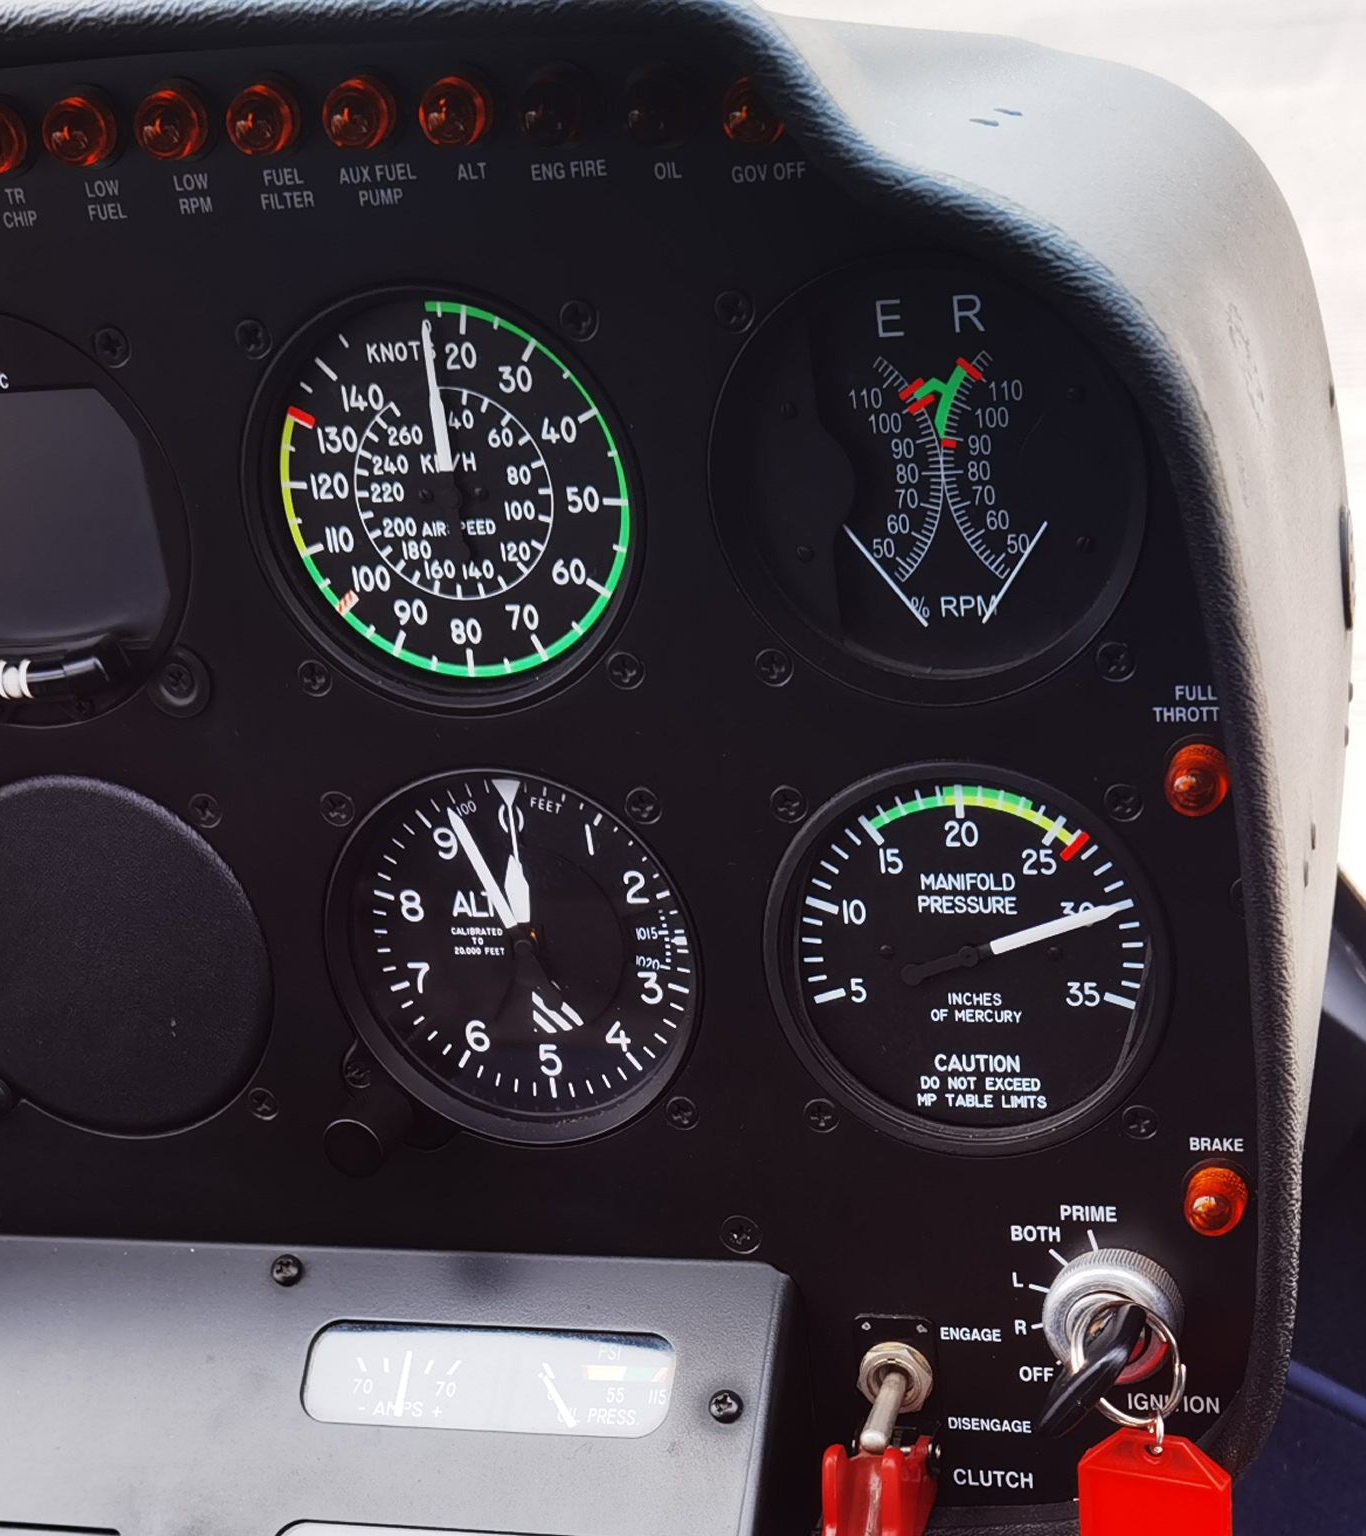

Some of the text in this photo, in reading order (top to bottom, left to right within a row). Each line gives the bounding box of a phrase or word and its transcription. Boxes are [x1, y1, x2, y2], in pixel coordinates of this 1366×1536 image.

[263, 167, 304, 186] FUEL
[339, 162, 417, 184] AUX FUEL
[456, 163, 487, 181] ALT
[531, 159, 607, 182] ENG FIRE
[654, 162, 682, 180] OIL
[731, 162, 806, 183] GOV OFF
[85, 179, 120, 198] LOW
[173, 172, 208, 192] LOW
[4, 188, 25, 205] TR
[180, 197, 213, 215] RPM
[261, 190, 315, 211] FILTER
[359, 188, 404, 207] PUMP
[3, 209, 37, 229] CHIP
[87, 202, 127, 222] FUEL
[875, 294, 985, 338] E R
[445, 342, 477, 369] 20
[498, 366, 532, 393] 30
[341, 383, 384, 413] 140
[317, 426, 358, 454] 130
[541, 416, 577, 444] 40
[310, 473, 349, 500] 120
[566, 486, 600, 513] 50
[352, 564, 391, 593] 100
[552, 559, 586, 585] 60
[940, 595, 998, 618] RPM
[505, 604, 539, 631] 70
[450, 618, 482, 645] 80
[1175, 685, 1217, 701] FULL
[1152, 707, 1220, 722] THROTT
[530, 797, 562, 814] FEET
[945, 821, 978, 847] 20
[879, 848, 903, 874] 15
[1022, 849, 1056, 875] 25
[623, 870, 649, 904] 2
[920, 873, 1015, 891] MANIFOLD
[842, 900, 866, 925] 10
[917, 896, 1017, 915] PRESSURE
[451, 927, 503, 936] CALIBRATED
[637, 971, 663, 1004] 3
[1065, 982, 1100, 1006] 35
[948, 992, 1001, 1006] INCHES
[931, 1009, 1022, 1024] OF MERCURY
[539, 1044, 563, 1076] 5
[935, 1054, 1021, 1073] CAUTION
[920, 1076, 1041, 1091] DO NOT EXCEED
[917, 1093, 1047, 1109] MP TABLE LIMITS
[1189, 1137, 1244, 1152] BRAKE
[1059, 1205, 1118, 1223] PRIME
[1011, 1225, 1061, 1243] BOTH
[940, 1327, 1002, 1343] ENGAGE
[1019, 1366, 1054, 1383] OFF
[948, 1417, 1032, 1434] DISENGAGE
[953, 1468, 1034, 1489] CLUTCH
